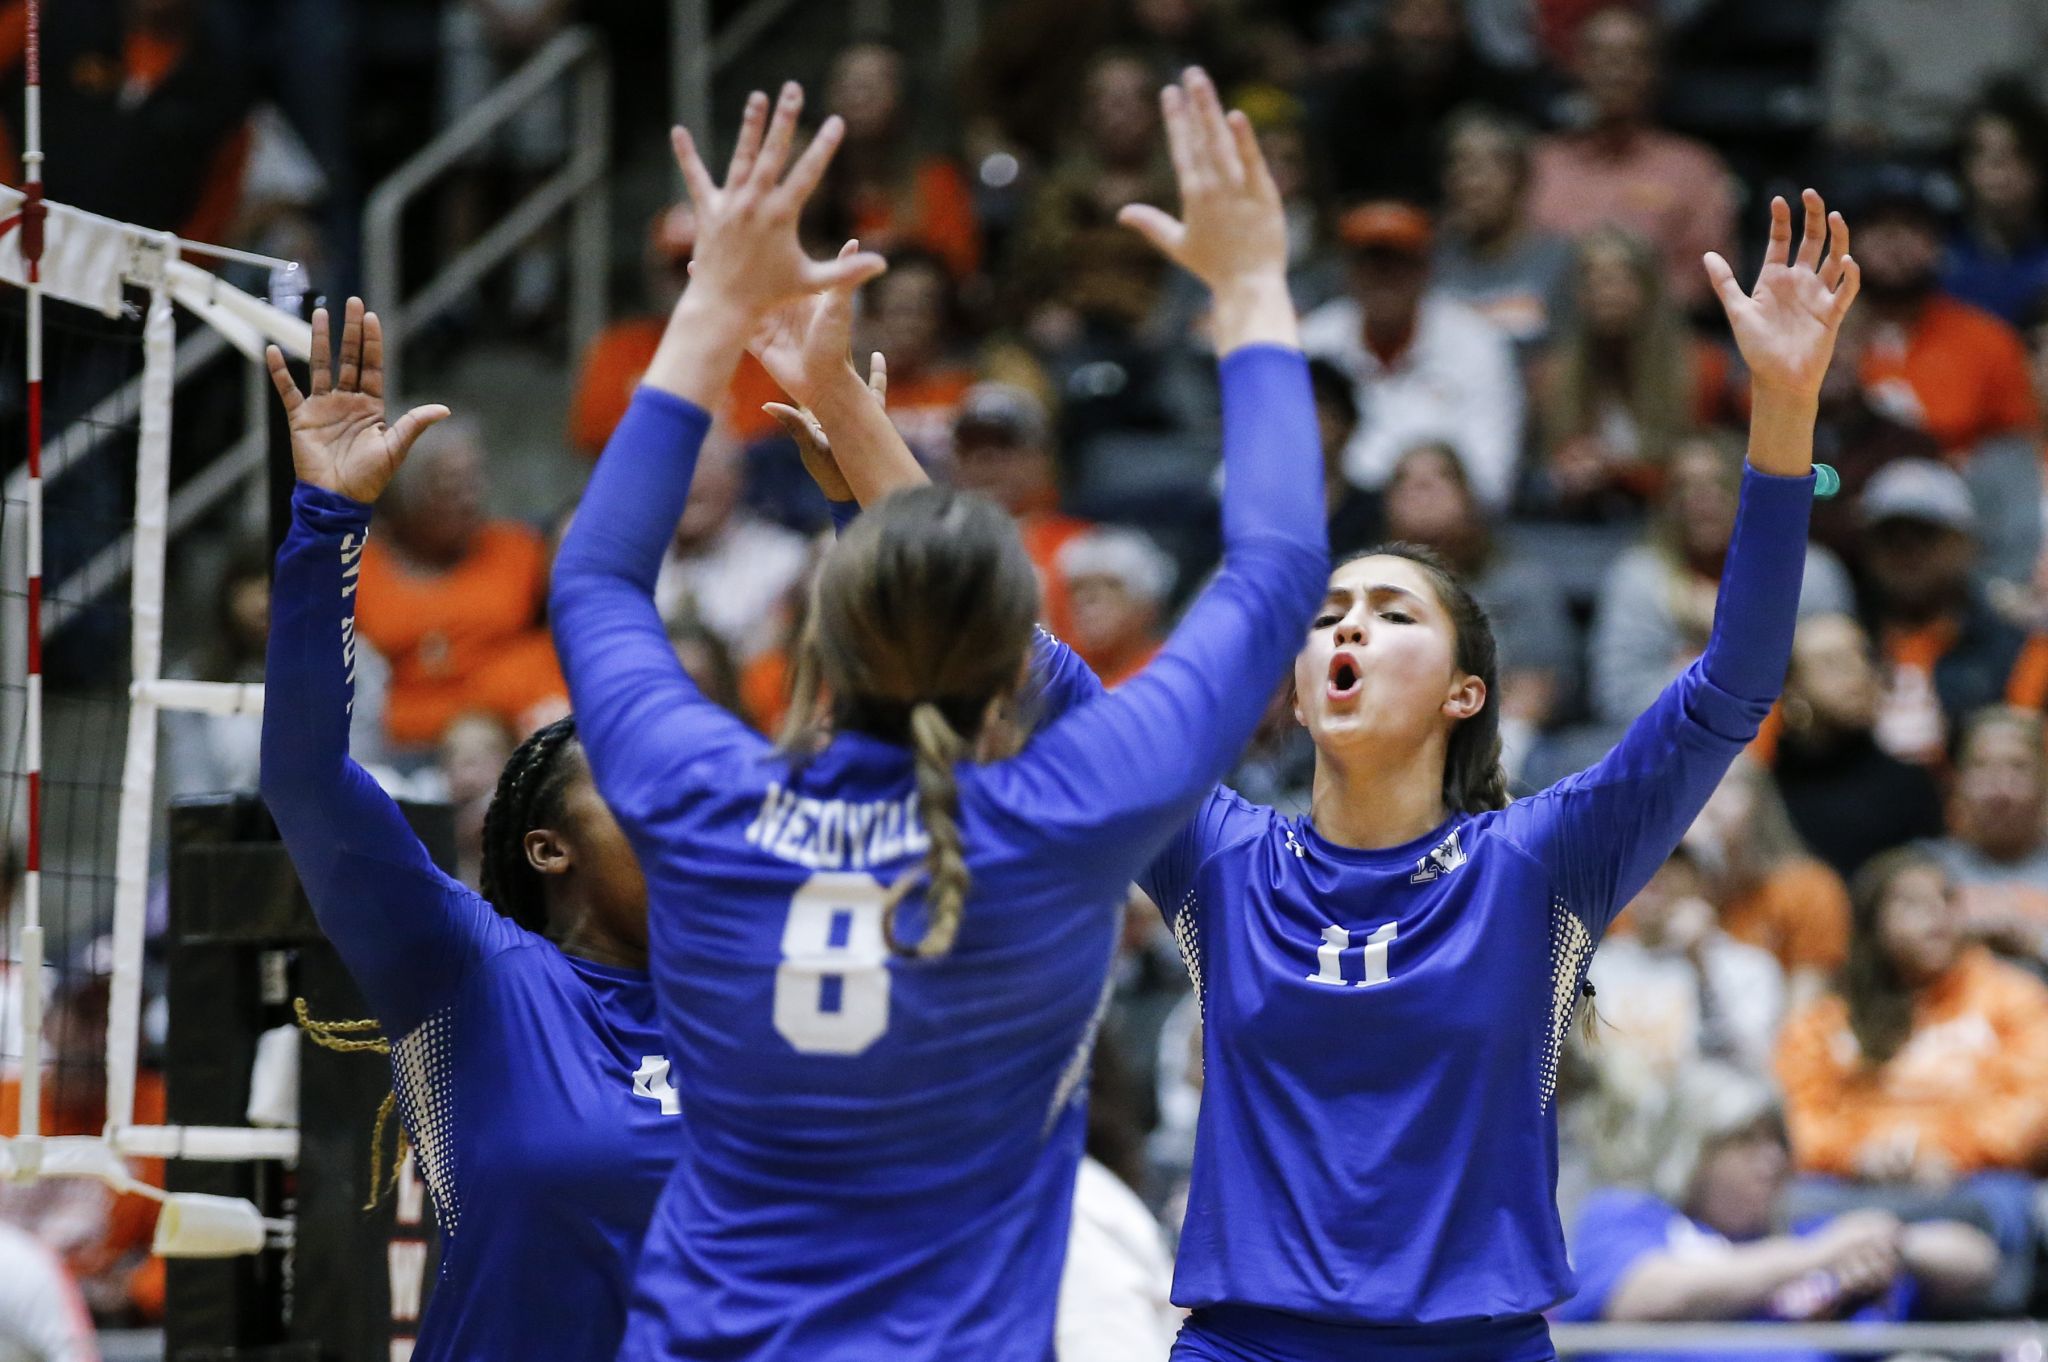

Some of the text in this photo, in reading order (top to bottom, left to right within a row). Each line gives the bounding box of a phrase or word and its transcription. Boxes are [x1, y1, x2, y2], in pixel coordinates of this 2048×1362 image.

[773, 872, 892, 1054] 8
[1306, 921, 1398, 988] 11
[632, 1055, 682, 1115] 4
